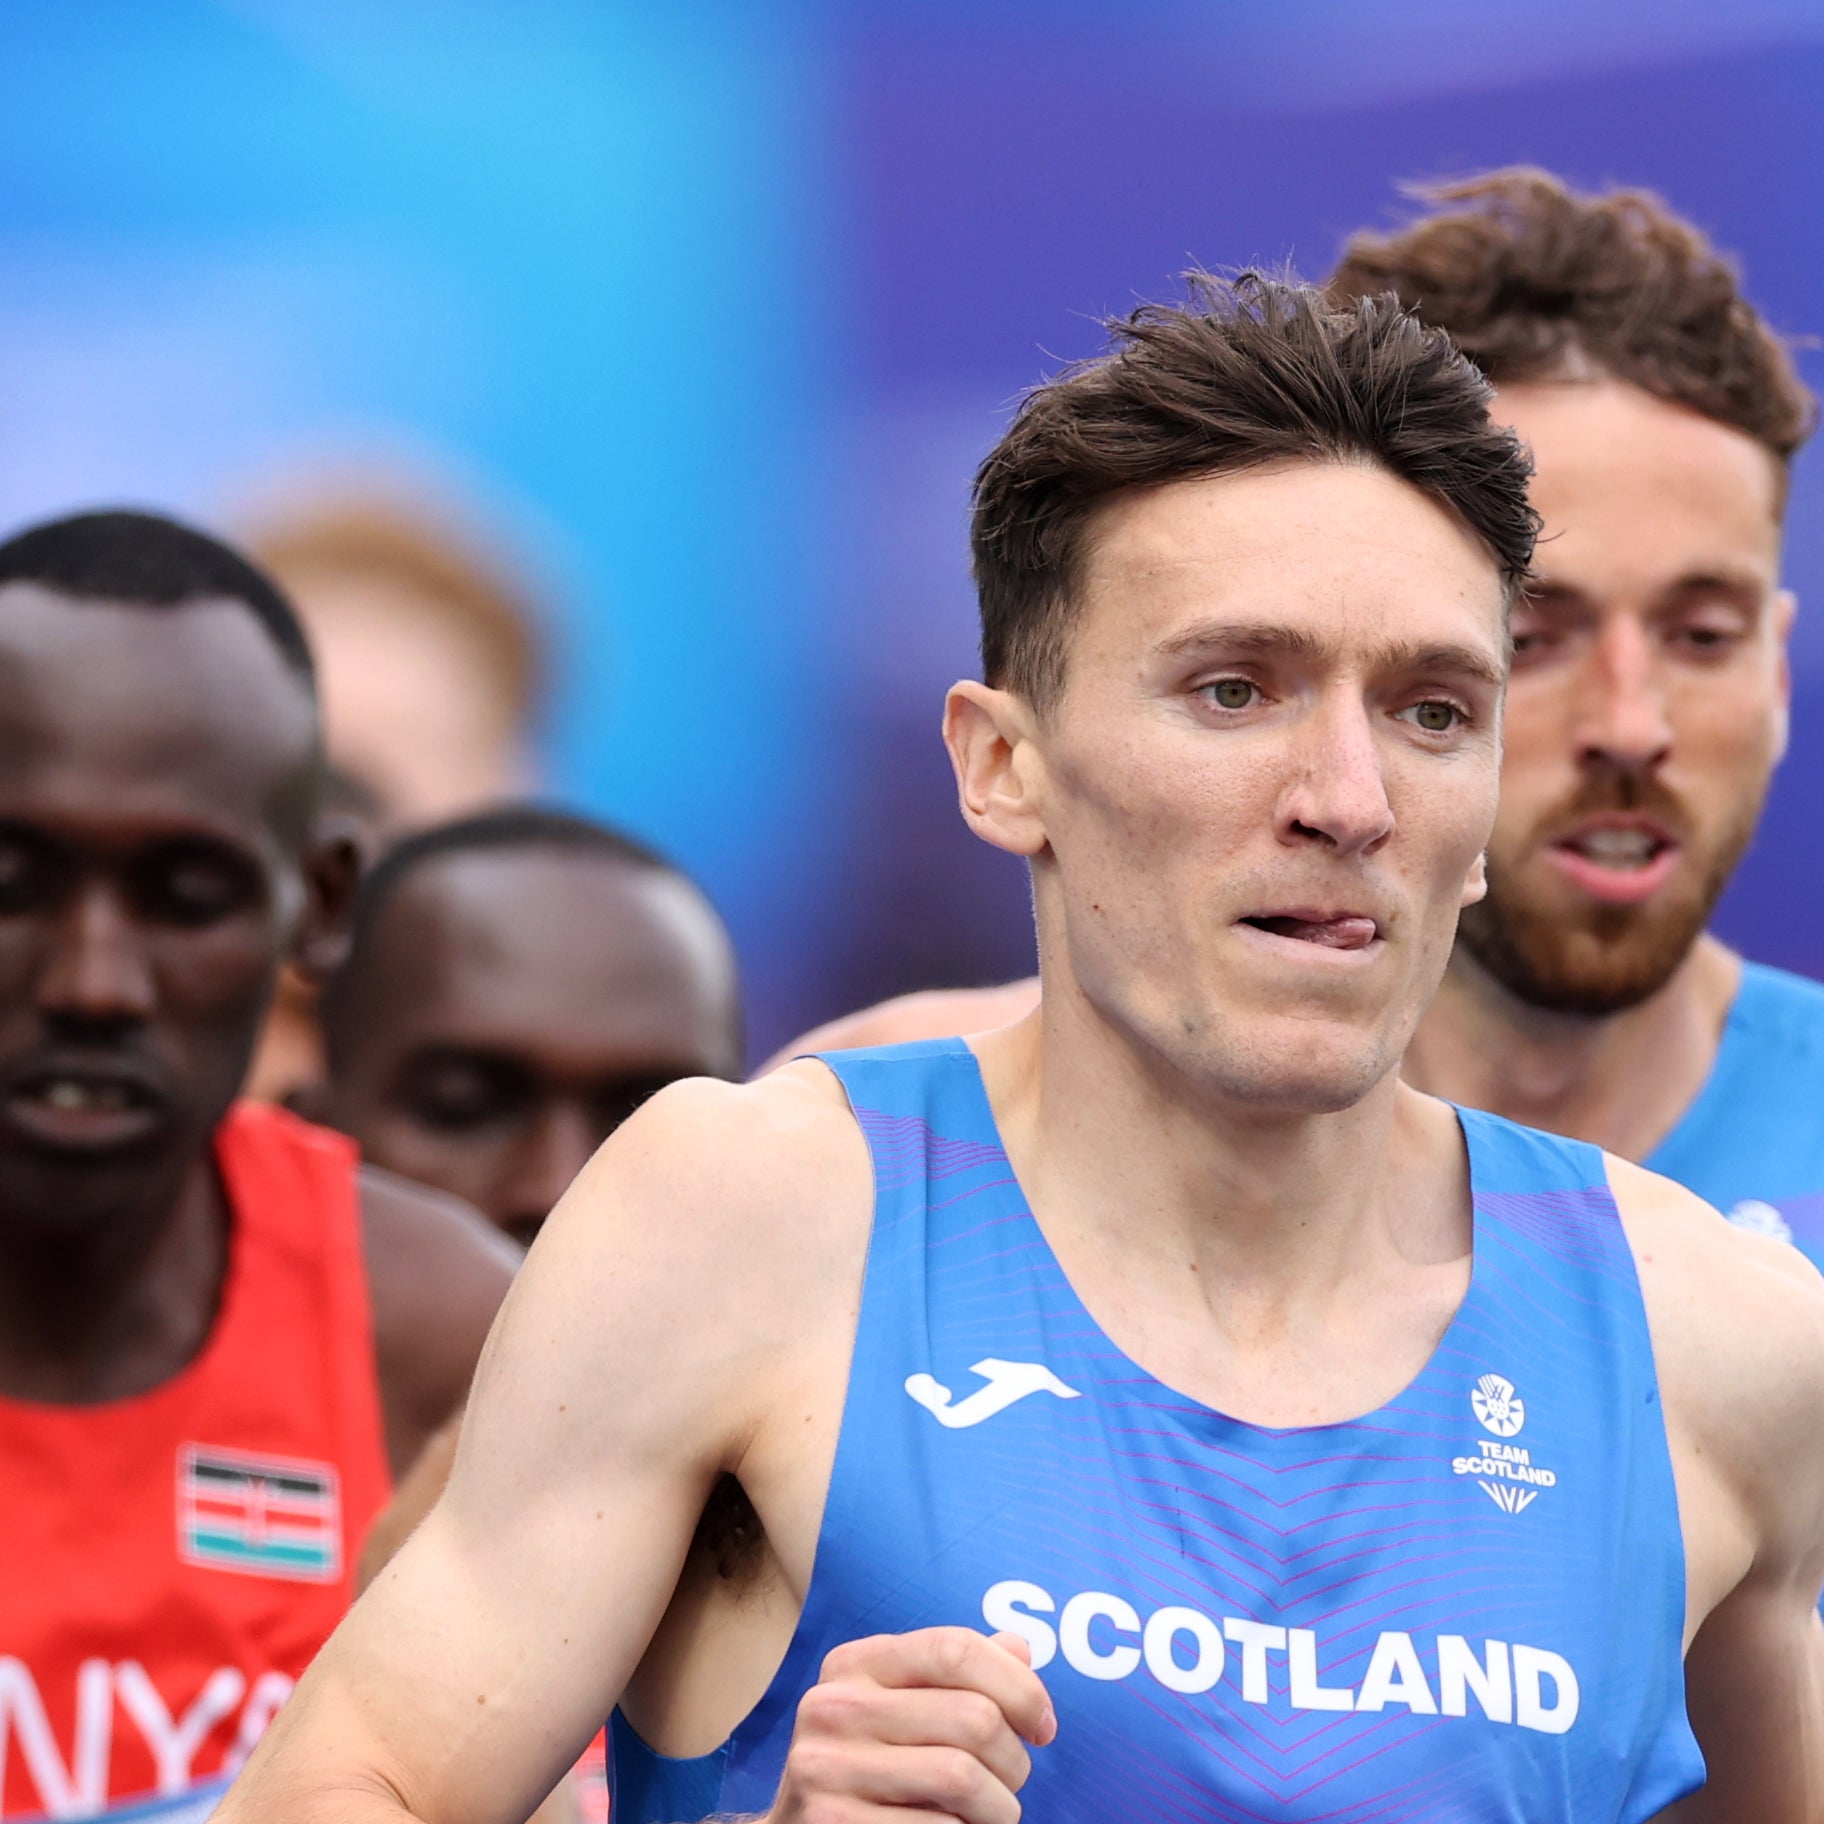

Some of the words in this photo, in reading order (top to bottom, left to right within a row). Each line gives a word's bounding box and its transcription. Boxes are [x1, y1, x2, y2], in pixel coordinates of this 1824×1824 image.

[1477, 1440, 1530, 1465] TEAM
[1452, 1457, 1556, 1487] SCOTLAND
[981, 1579, 1577, 1735] SCOTLAND
